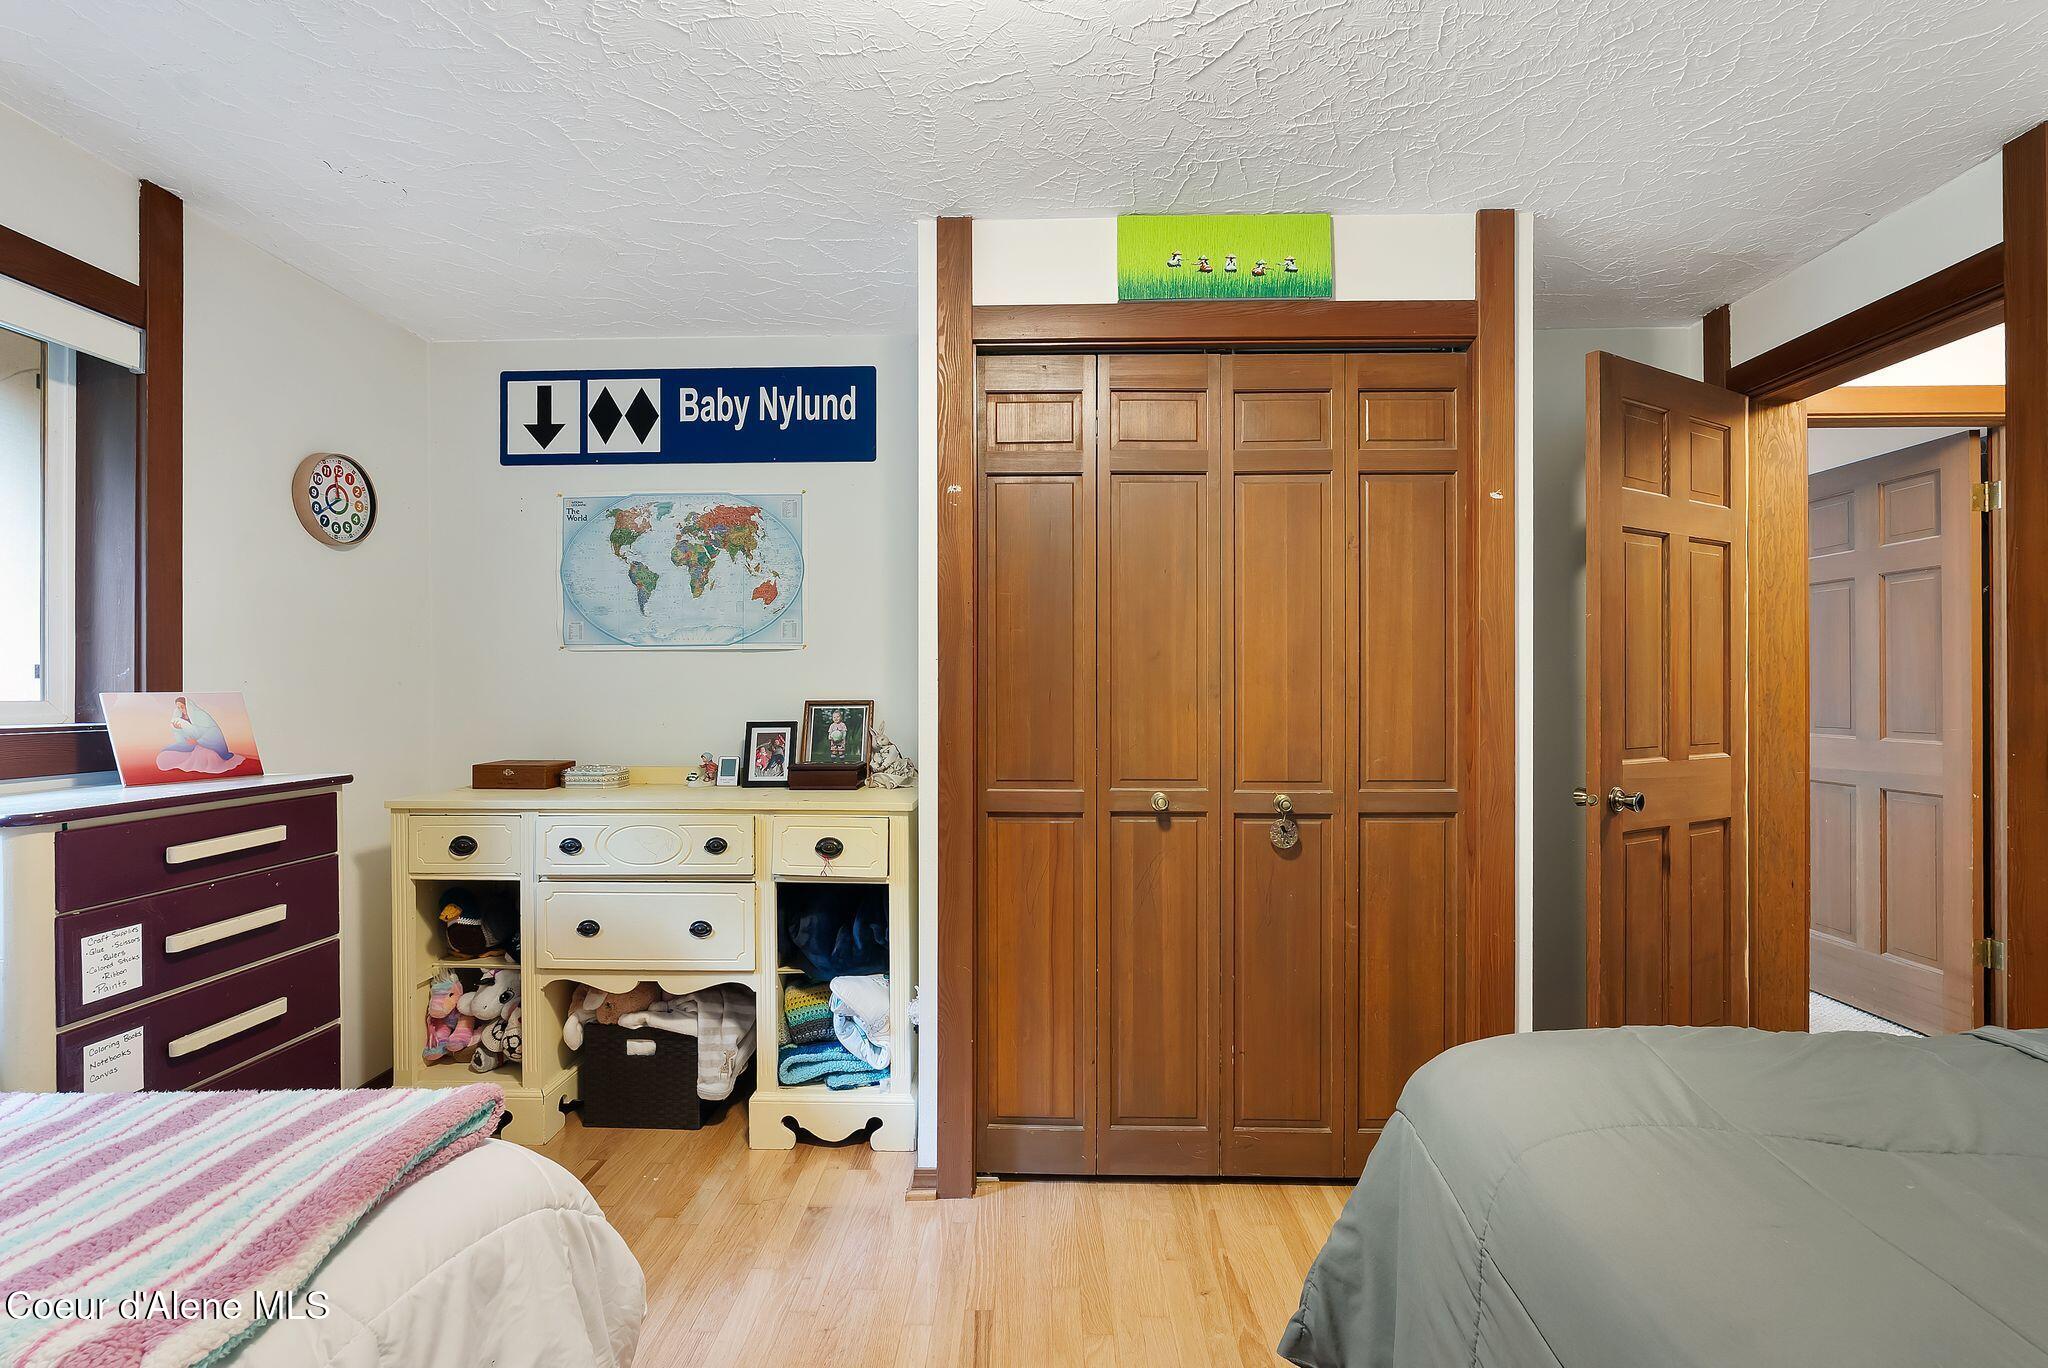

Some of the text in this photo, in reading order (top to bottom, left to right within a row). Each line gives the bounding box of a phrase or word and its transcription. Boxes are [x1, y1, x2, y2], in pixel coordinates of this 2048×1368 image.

[679, 385, 856, 431] Baby Nylund
[87, 926, 139, 946] Craft Supplies
[88, 1040, 121, 1057] Coloring
[89, 1049, 132, 1070] Notebooks
[89, 1067, 118, 1084] Canvas
